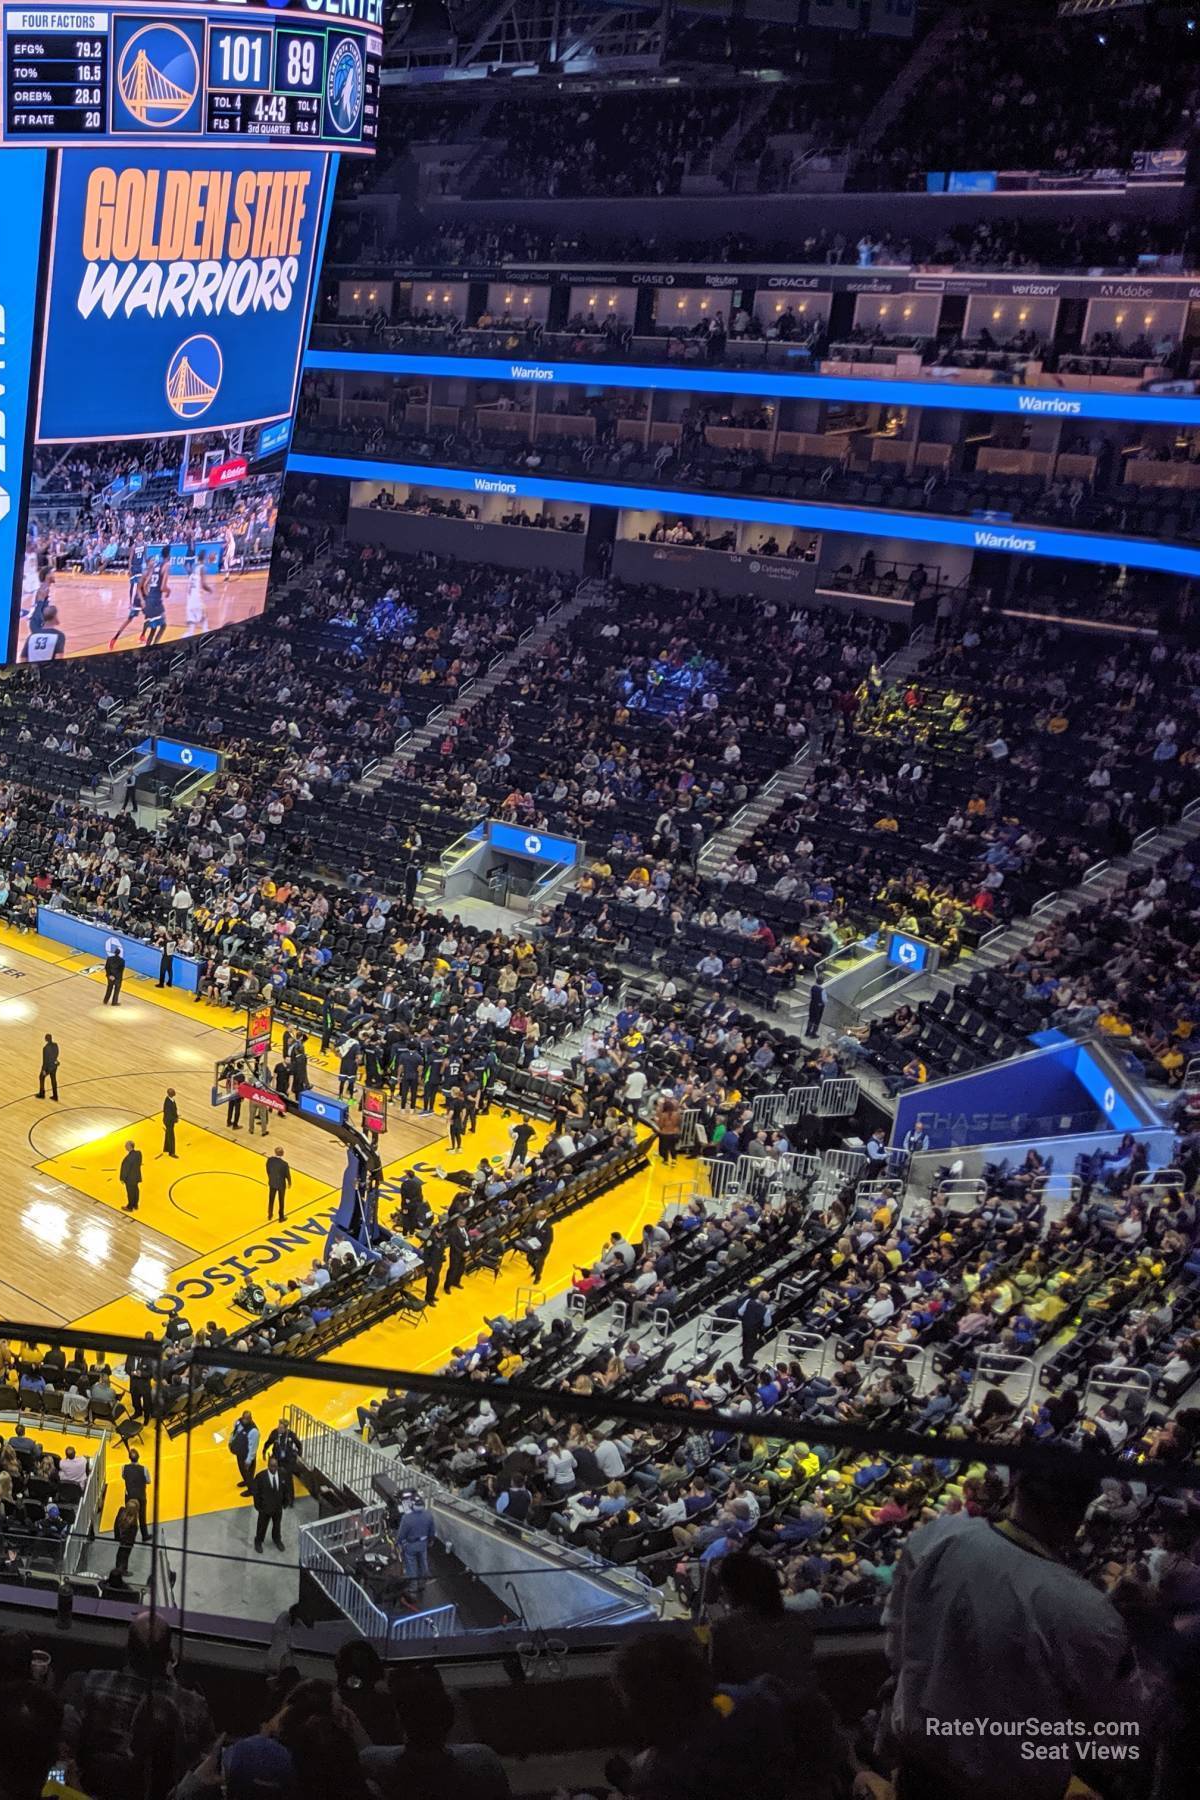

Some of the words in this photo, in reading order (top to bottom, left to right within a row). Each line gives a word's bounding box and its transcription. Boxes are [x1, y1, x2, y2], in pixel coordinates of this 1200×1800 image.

[22, 14, 48, 28] FOUR
[50, 15, 95, 28] FACTORS
[14, 45, 45, 55] EFG%
[76, 43, 102, 58] 79.2
[219, 35, 262, 82] 101
[287, 40, 315, 86] 89
[14, 69, 38, 78] TO%
[78, 66, 101, 81] 16.5
[14, 91, 52, 101] OREB%
[75, 89, 101, 105] 28.0
[214, 97, 231, 108] TOL
[234, 94, 241, 110] 4
[254, 95, 287, 122] 4:43
[297, 100, 310, 111] TOL
[312, 99, 317, 113] 4
[14, 115, 27, 125] FT
[28, 115, 55, 125] RATE
[85, 112, 101, 128] 20
[213, 118, 230, 129] FLS
[236, 116, 241, 131] 1
[296, 121, 309, 132] FLS
[311, 119, 316, 134] 4
[248, 124, 260, 133] 3rd
[260, 124, 291, 135] QUARTER
[82, 166, 233, 262] GOLDEN
[228, 169, 312, 260] STATE
[505, 271, 528, 281] Google
[530, 271, 550, 280] Cloud
[632, 275, 663, 285] CHASE
[705, 275, 738, 285] Rakuten
[768, 277, 819, 288] ORACLE
[77, 256, 299, 320] WARRIORS
[1012, 284, 1054, 296] verizon
[1114, 285, 1153, 298] Adobe
[511, 365, 554, 380] Warriors
[1018, 396, 1081, 414] Warriors
[474, 477, 516, 494] Warriors
[974, 531, 1037, 551] Warriors
[450, 1066, 460, 1076] 12
[916, 1111, 998, 1131] CHASE
